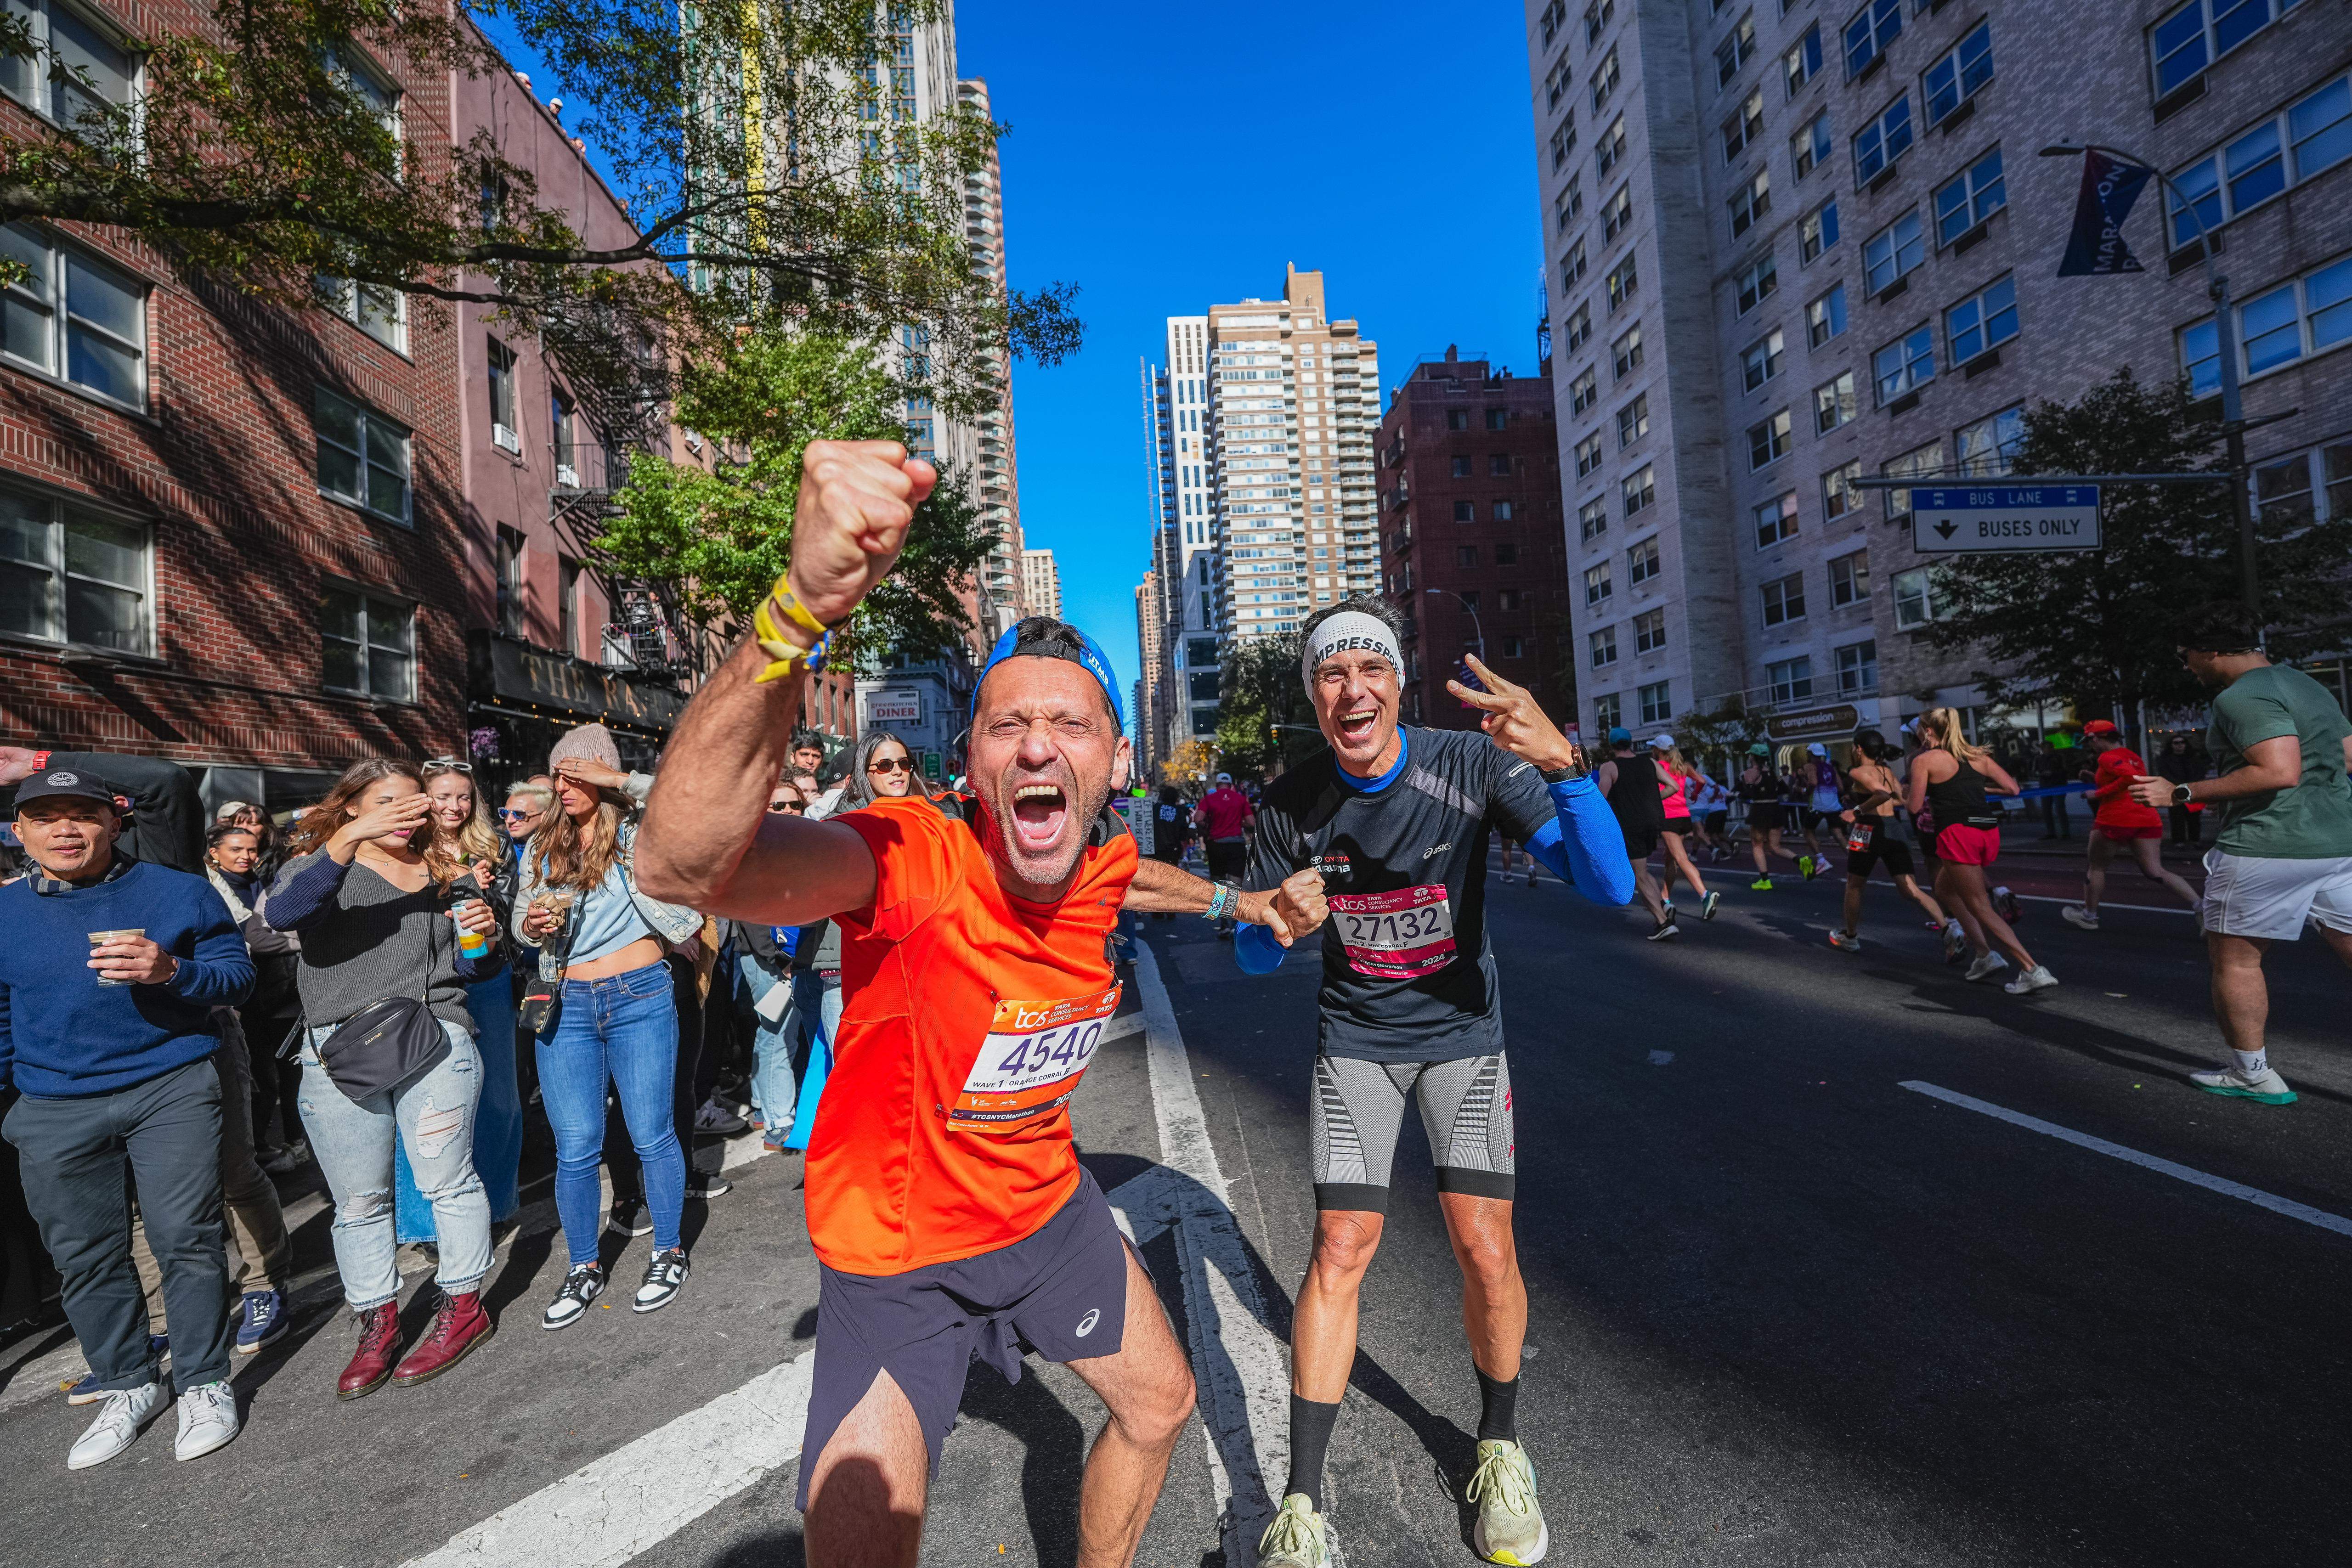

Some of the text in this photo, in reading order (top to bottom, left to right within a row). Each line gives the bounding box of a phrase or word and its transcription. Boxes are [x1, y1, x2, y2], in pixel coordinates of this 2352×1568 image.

[2093, 165, 2127, 271] MARON
[1969, 491, 2042, 505] BUS LANE
[1979, 518, 2081, 537] BUSES ONLY
[1310, 637, 1402, 684] COMPRESSPORT
[520, 651, 590, 704] THE
[876, 707, 916, 717] DINER
[1341, 897, 1367, 911] tcs
[1368, 897, 1403, 906] CONSULTANCY
[1413, 896, 1432, 904] TATA
[1346, 907, 1442, 942] 27132
[1360, 958, 1403, 970] #TSNYCMarathon
[1421, 953, 1445, 967] 2024
[1050, 1004, 1090, 1017] CONSULTANCY
[1095, 1004, 1113, 1014] TATA
[1014, 1007, 1050, 1029] tcs
[1047, 1014, 1072, 1024] SERVICES
[998, 1022, 1102, 1076] 4540
[998, 1080, 1004, 1088] 1
[1009, 1077, 1037, 1086] ORANGE
[1038, 1071, 1063, 1081] CORRAL
[1063, 1067, 1071, 1076] B
[1053, 1091, 1072, 1107] 202
[971, 1110, 1035, 1120] #TCSNYCMarathon
